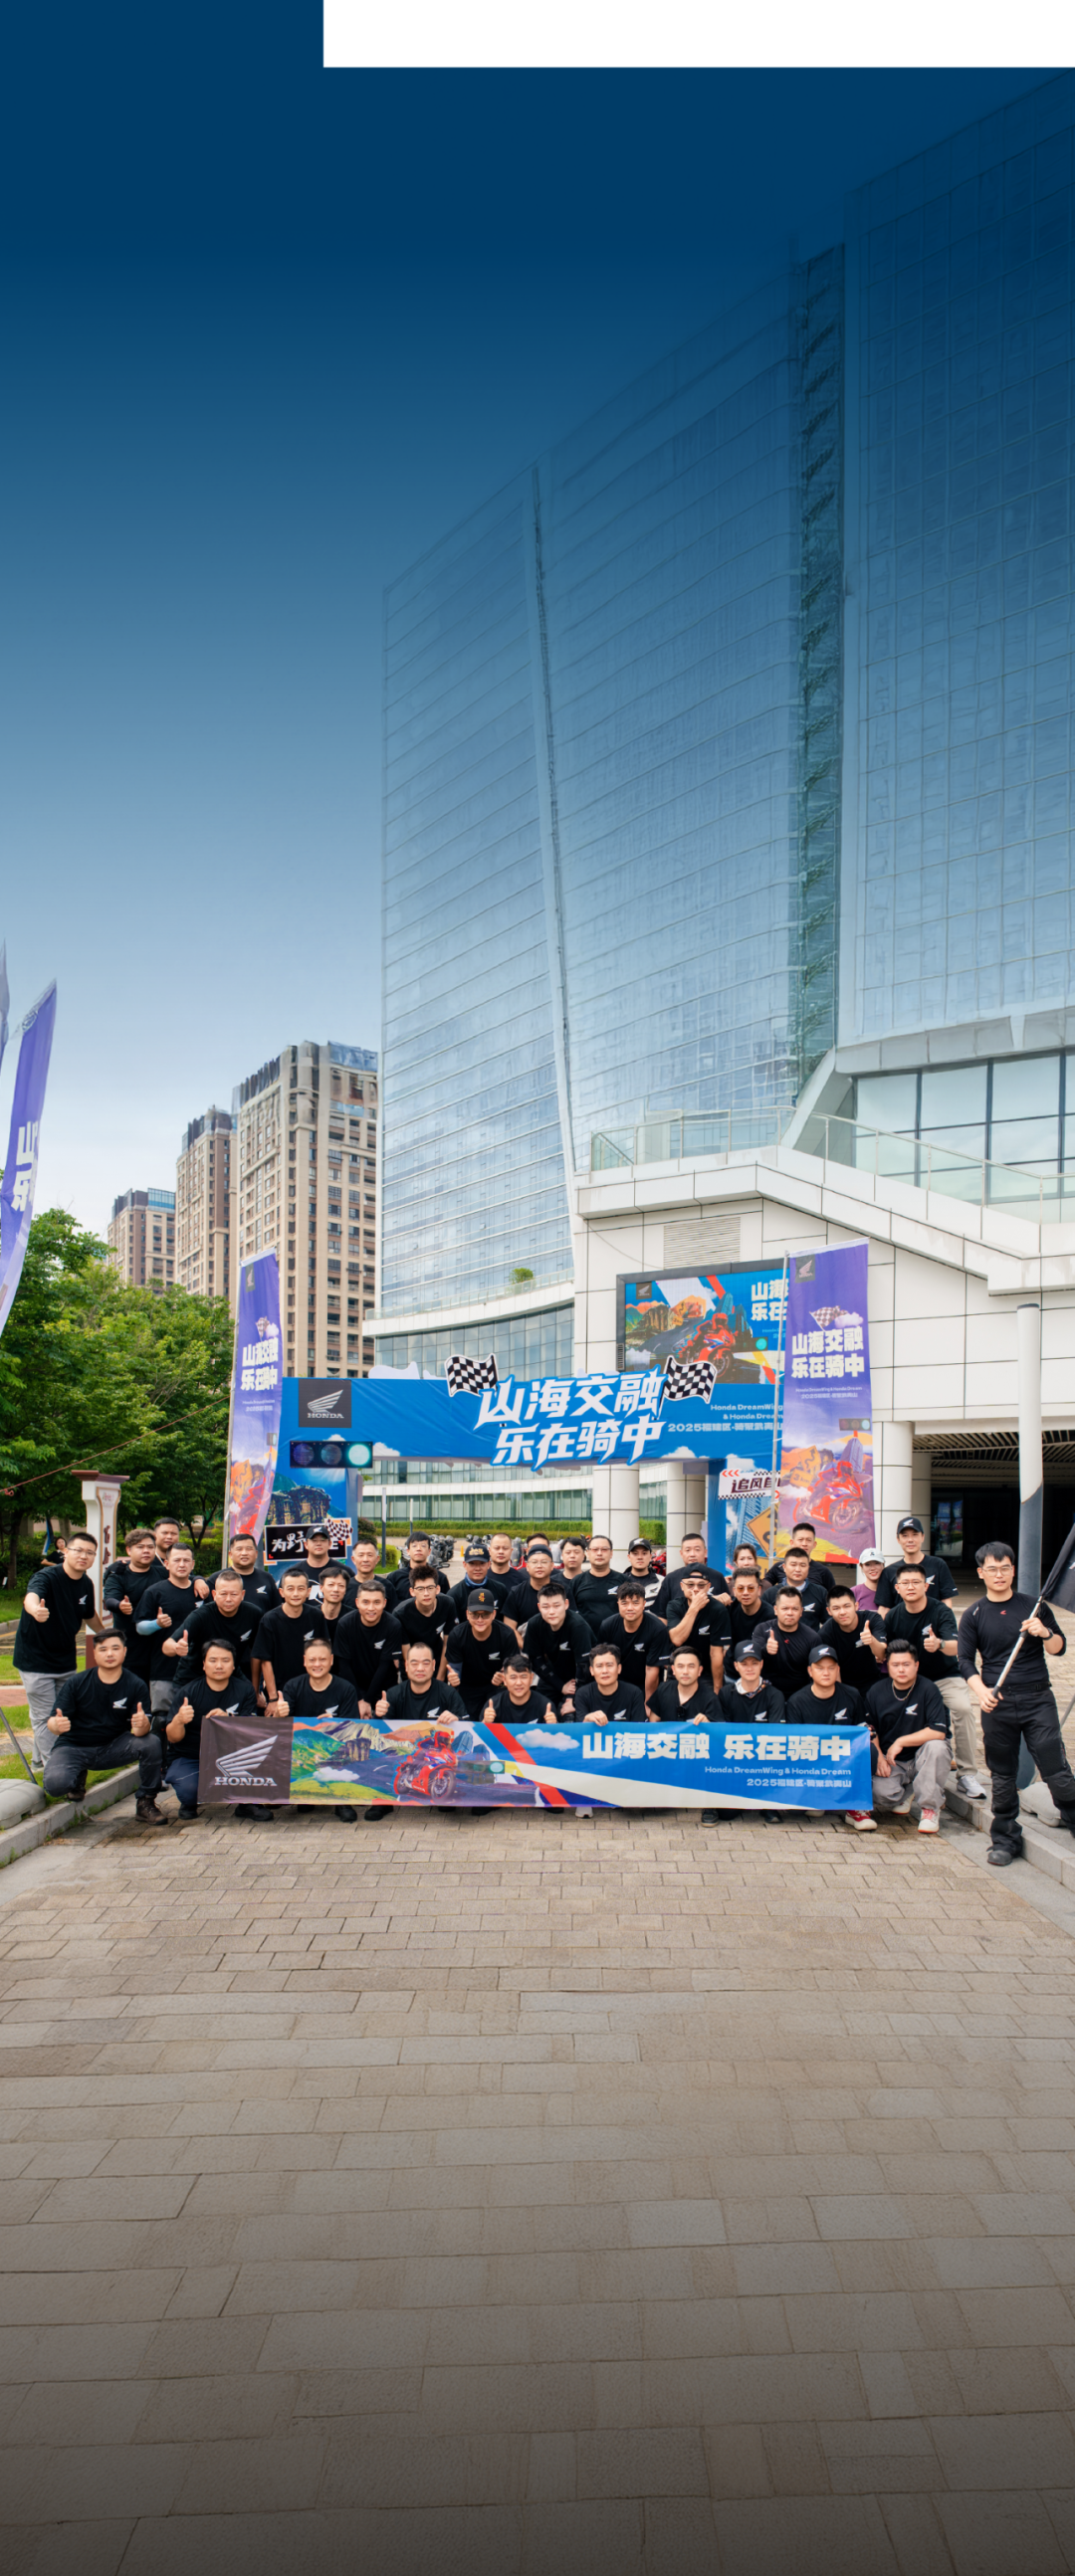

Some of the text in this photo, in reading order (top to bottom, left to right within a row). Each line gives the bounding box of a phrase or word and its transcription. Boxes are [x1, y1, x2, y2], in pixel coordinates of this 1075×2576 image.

[792, 1325, 864, 1355] 山海交融
[791, 1353, 865, 1379] 乐在骑中
[473, 1365, 668, 1431] 山海交融
[492, 1413, 667, 1471] 乐在骑中
[582, 1732, 851, 1761] 山海交融 乐在骑中
[214, 1776, 278, 1787] HONDA
[734, 1766, 783, 1776] DreamWing
